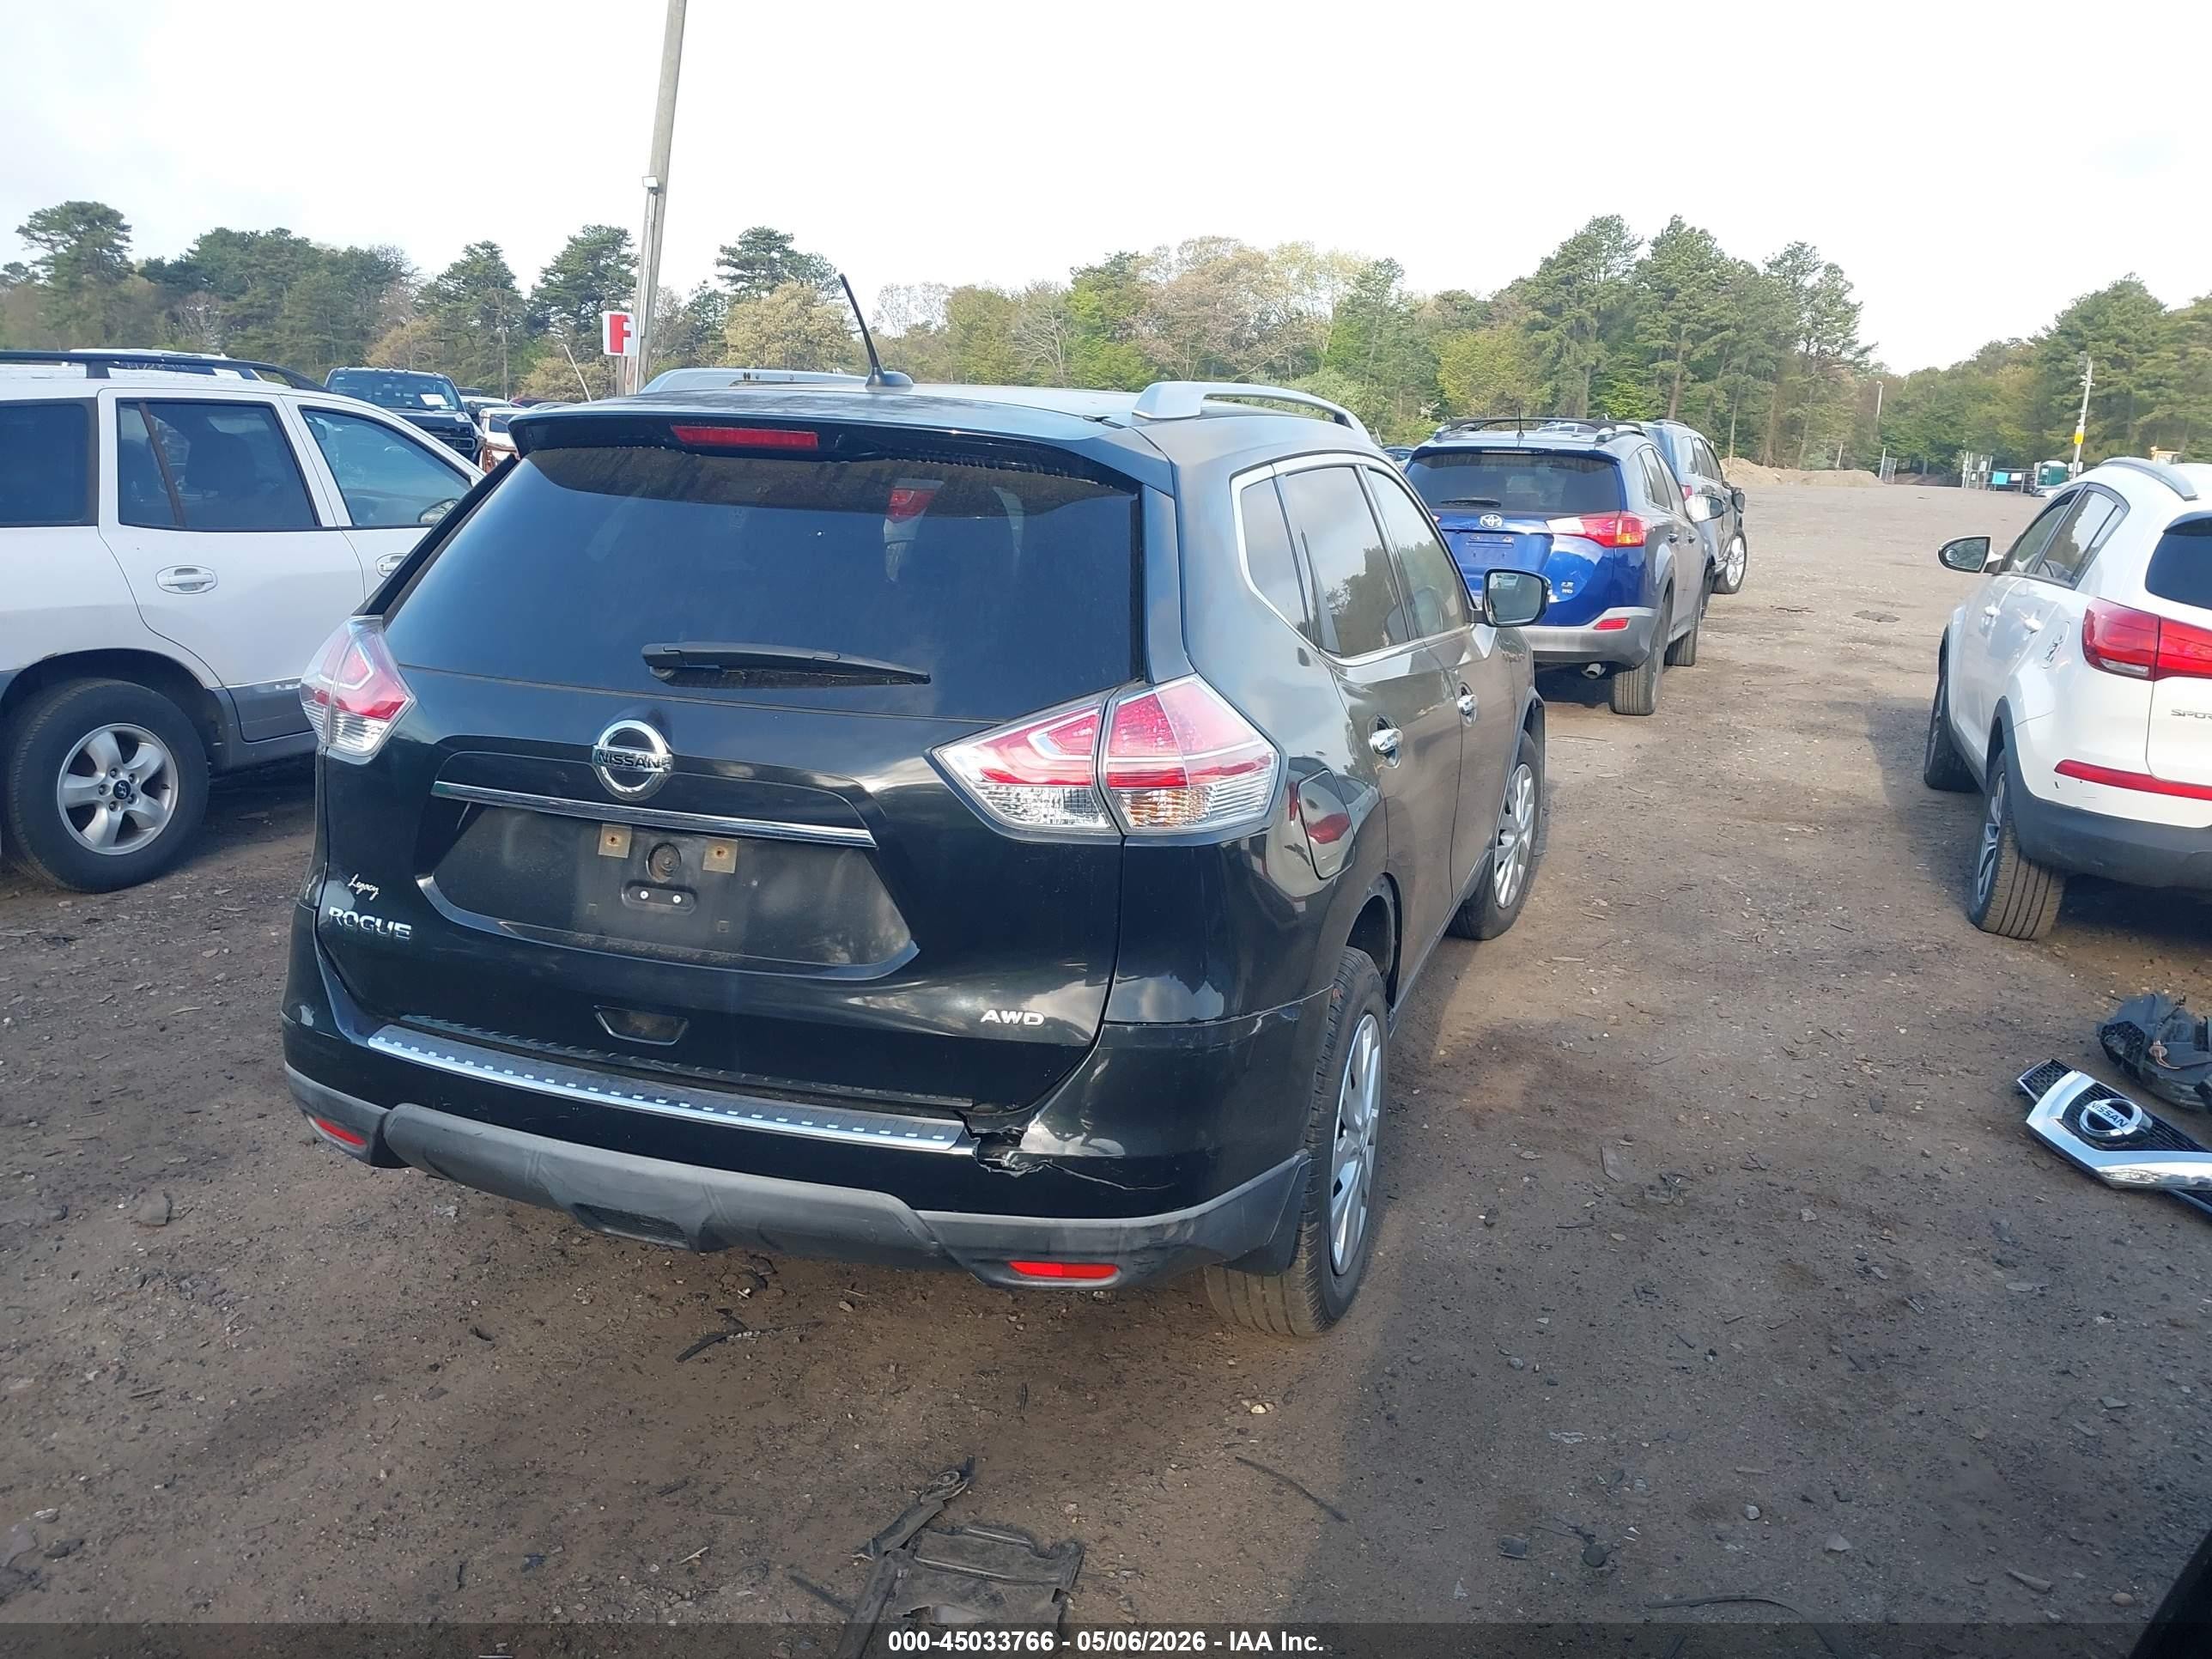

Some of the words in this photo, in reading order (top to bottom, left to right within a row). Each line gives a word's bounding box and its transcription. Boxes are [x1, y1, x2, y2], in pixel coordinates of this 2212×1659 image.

[610, 314, 631, 353] F
[599, 750, 660, 769] NISSAN
[328, 906, 412, 940] ROGUE
[980, 1009, 1045, 1026] AWD
[2092, 1102, 2129, 1127] NISSAN
